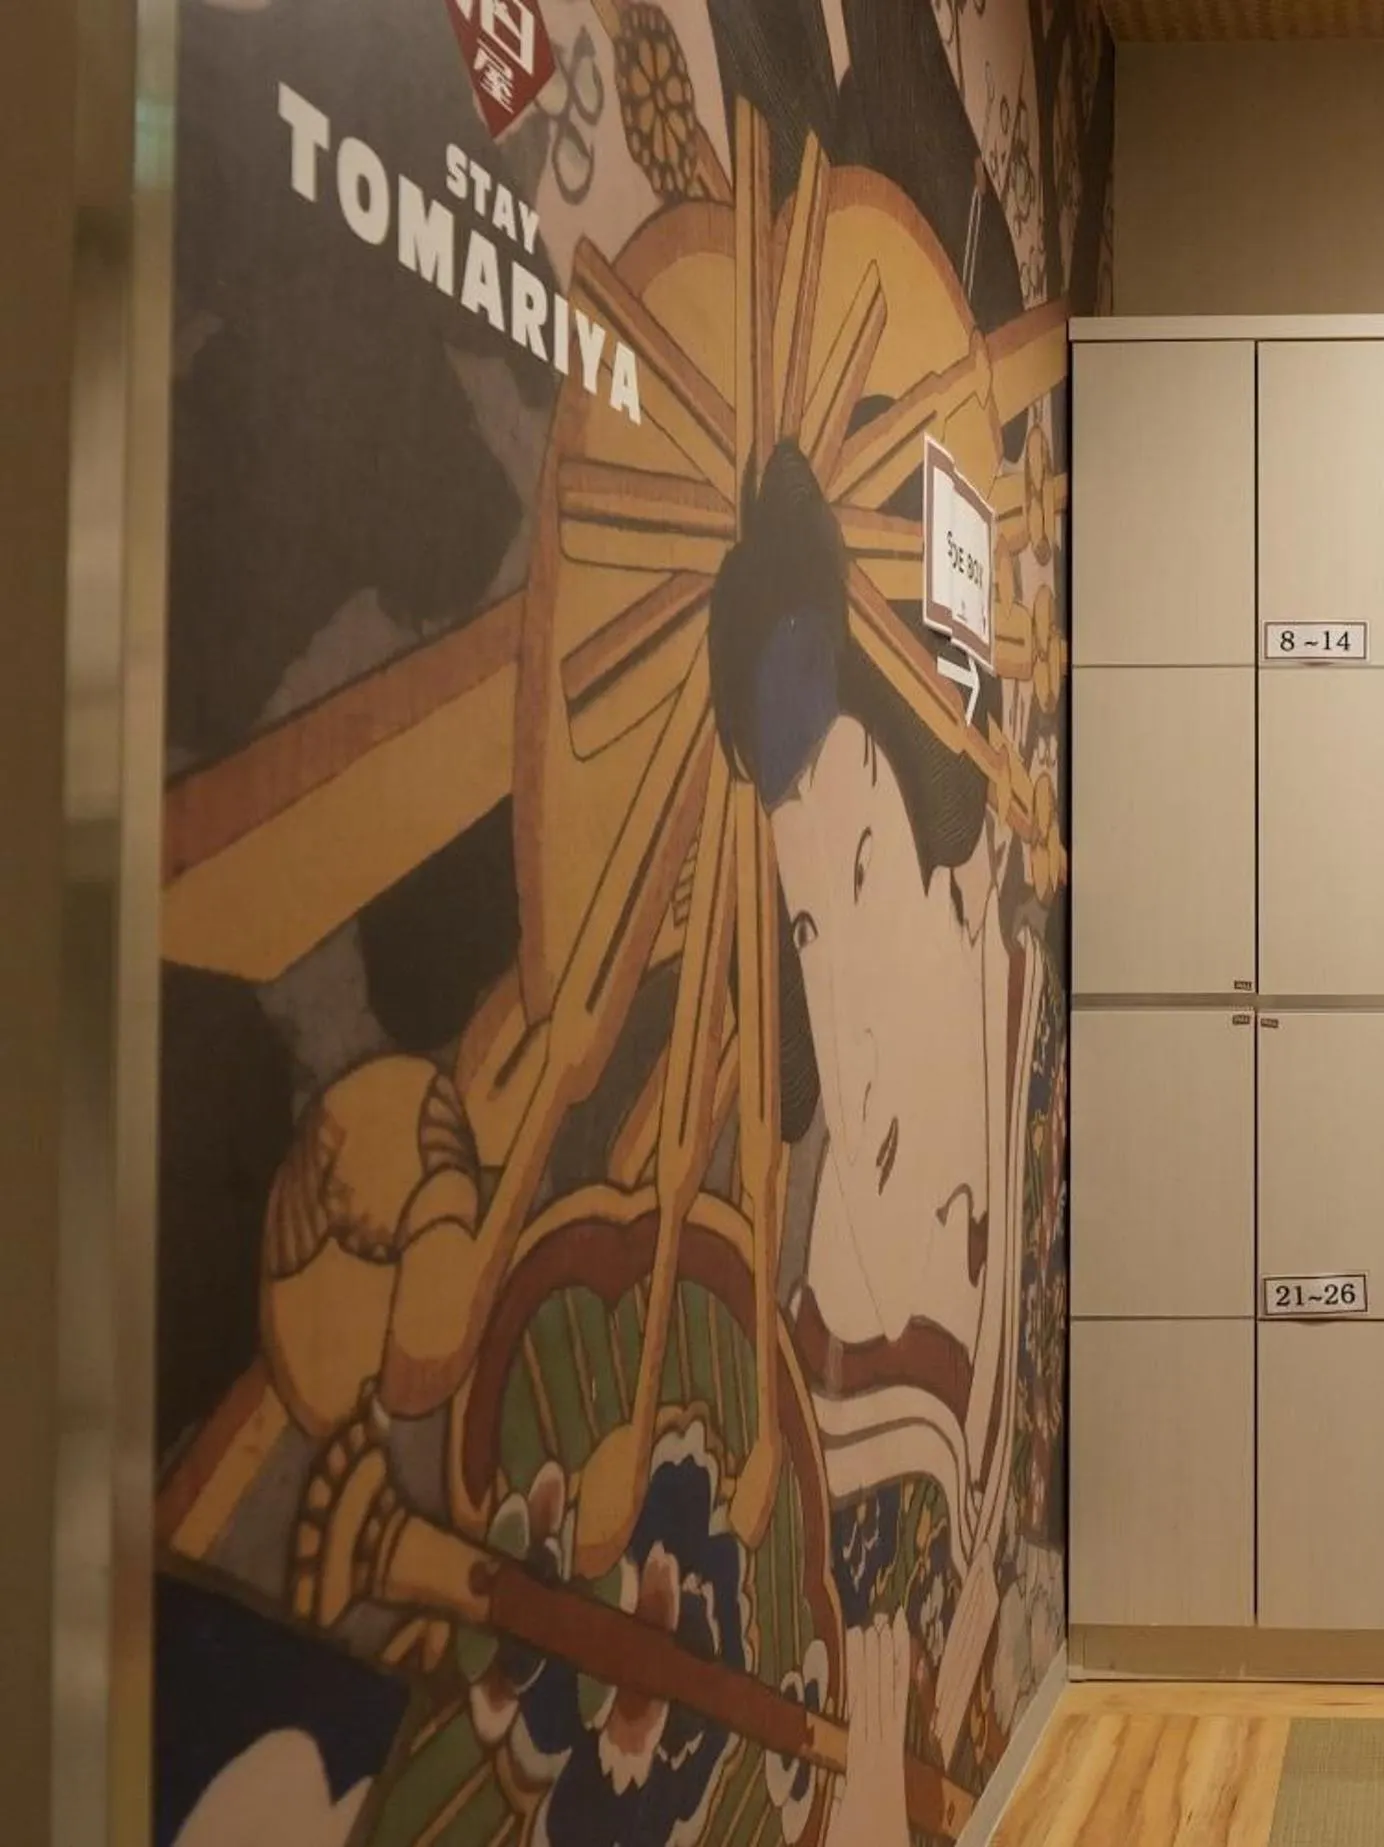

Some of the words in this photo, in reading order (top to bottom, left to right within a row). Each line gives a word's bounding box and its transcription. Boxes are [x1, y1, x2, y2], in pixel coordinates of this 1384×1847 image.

[278, 81, 642, 425] TOMARIYA
[446, 143, 539, 255] STAY
[1275, 1283, 1356, 1306] 21~26
